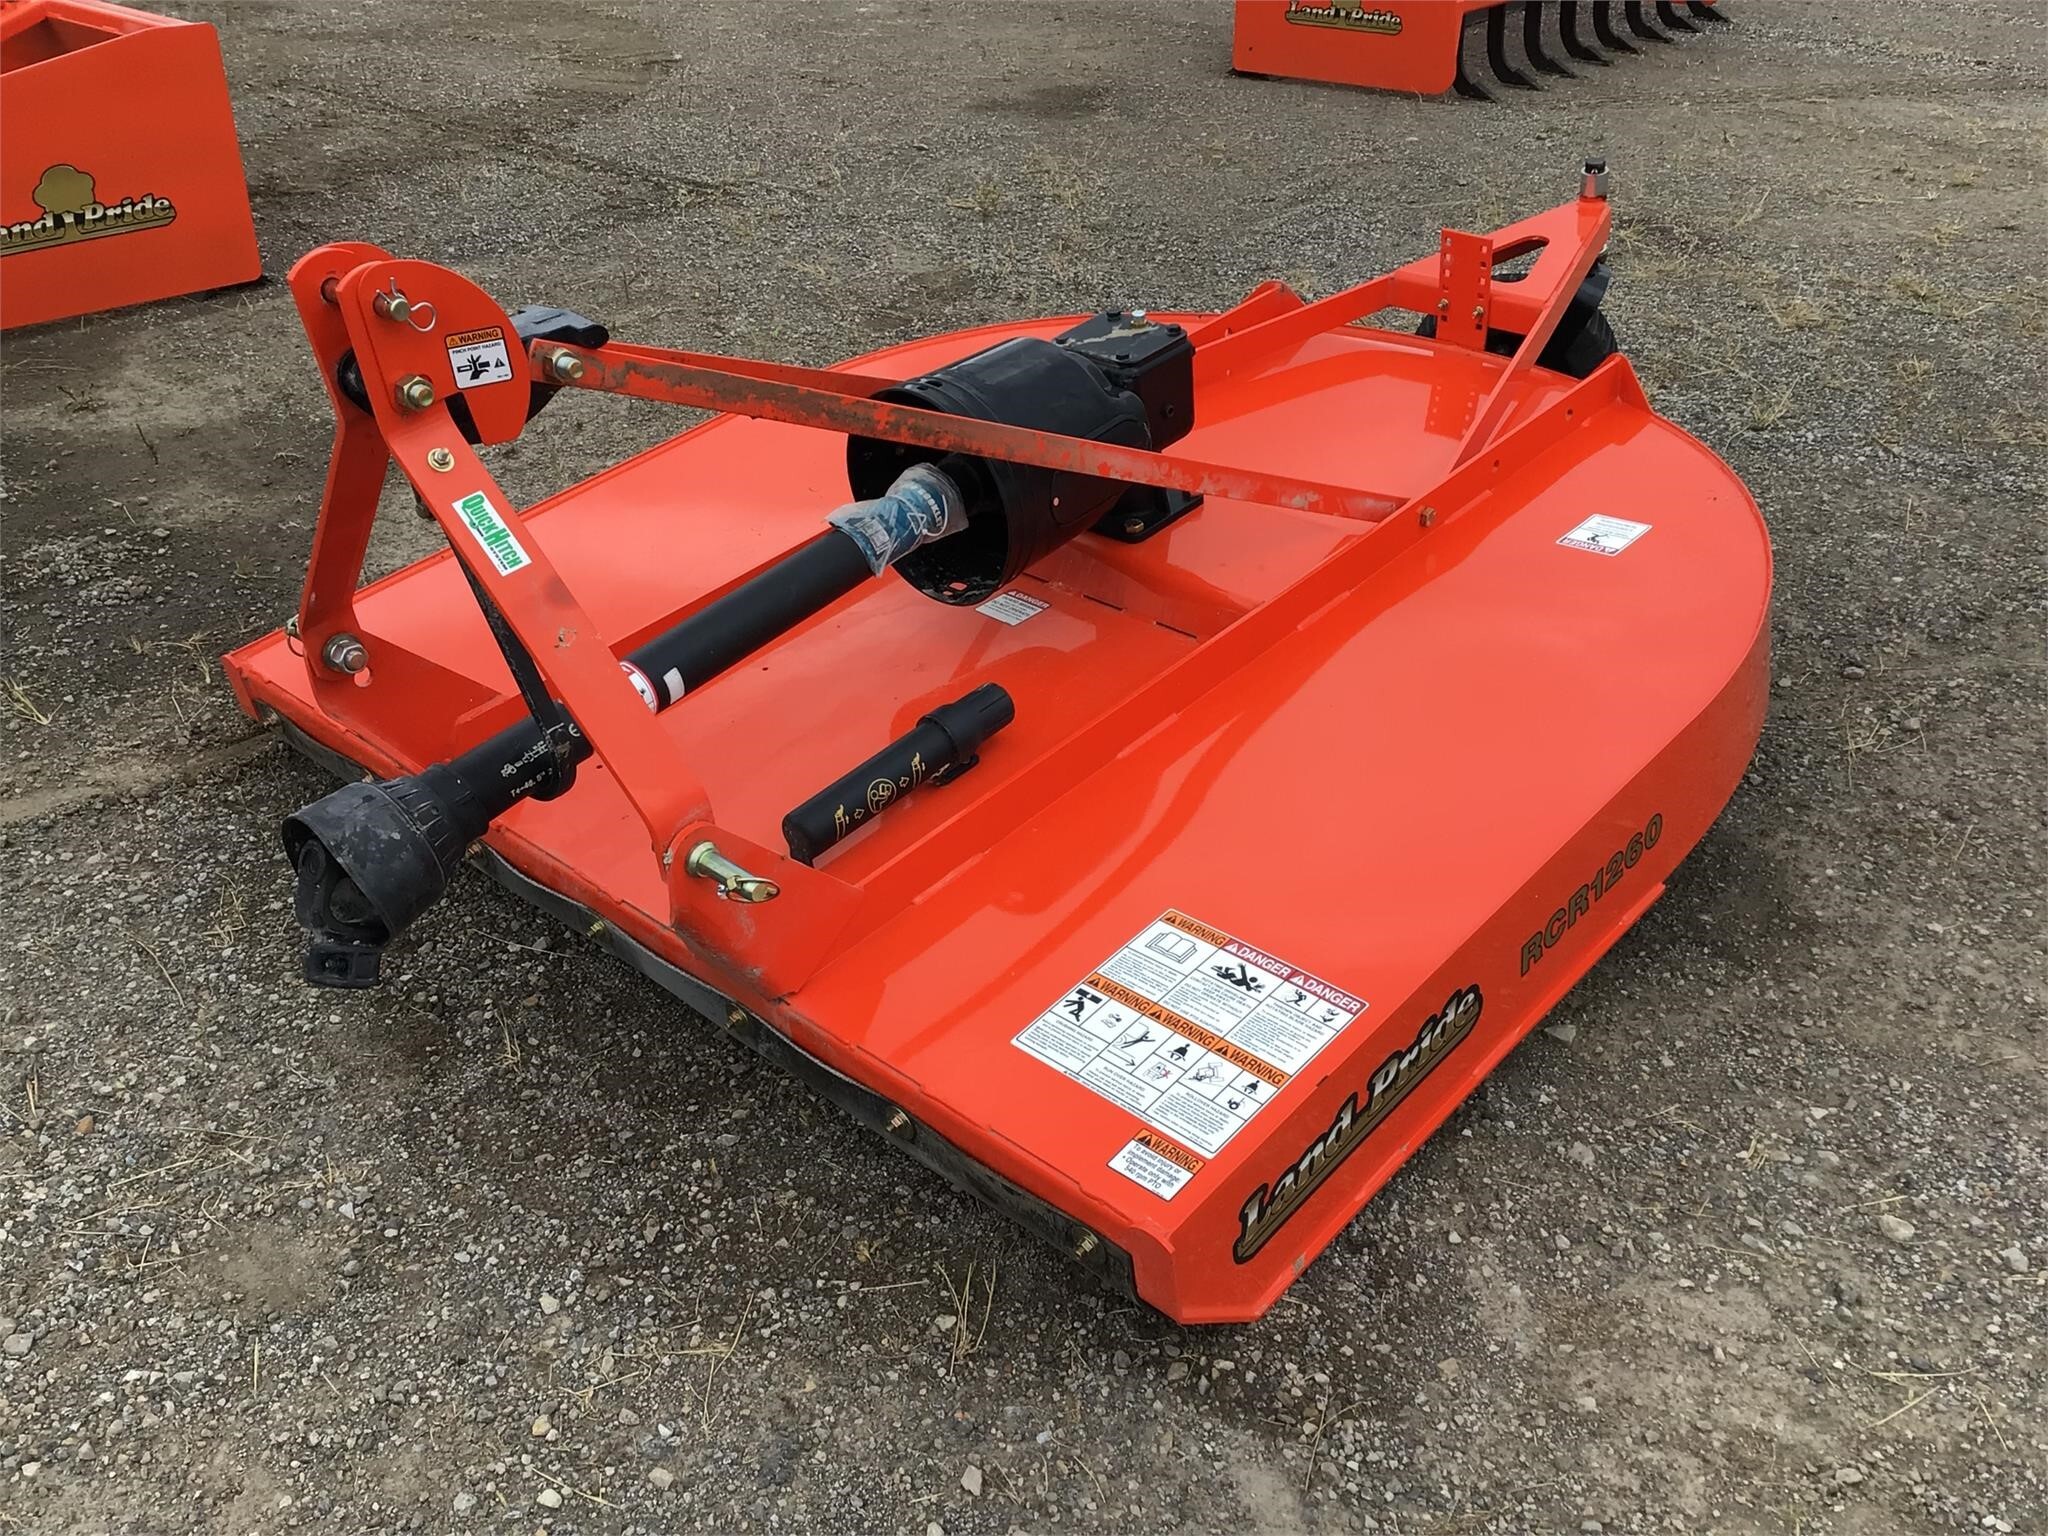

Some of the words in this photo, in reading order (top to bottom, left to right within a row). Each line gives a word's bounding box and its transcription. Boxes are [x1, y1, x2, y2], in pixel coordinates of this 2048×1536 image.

[1286, 0, 1337, 22] Land
[1348, 7, 1401, 28] Pride
[80, 194, 174, 232] Pride
[457, 328, 499, 344] WARNING
[1520, 812, 1663, 978] RCR1260
[1175, 917, 1227, 945] WARNING
[1235, 947, 1292, 978] DANGER
[1098, 980, 1152, 1012] WARNING
[1301, 979, 1362, 1013] DANGER
[1159, 1013, 1217, 1047] WARNING
[1226, 1049, 1286, 1085] WARNING
[1237, 1092, 1357, 1242] Land
[1368, 984, 1482, 1122] Pride
[1152, 1138, 1199, 1170] WARNING
[1147, 1177, 1162, 1189] PTO
